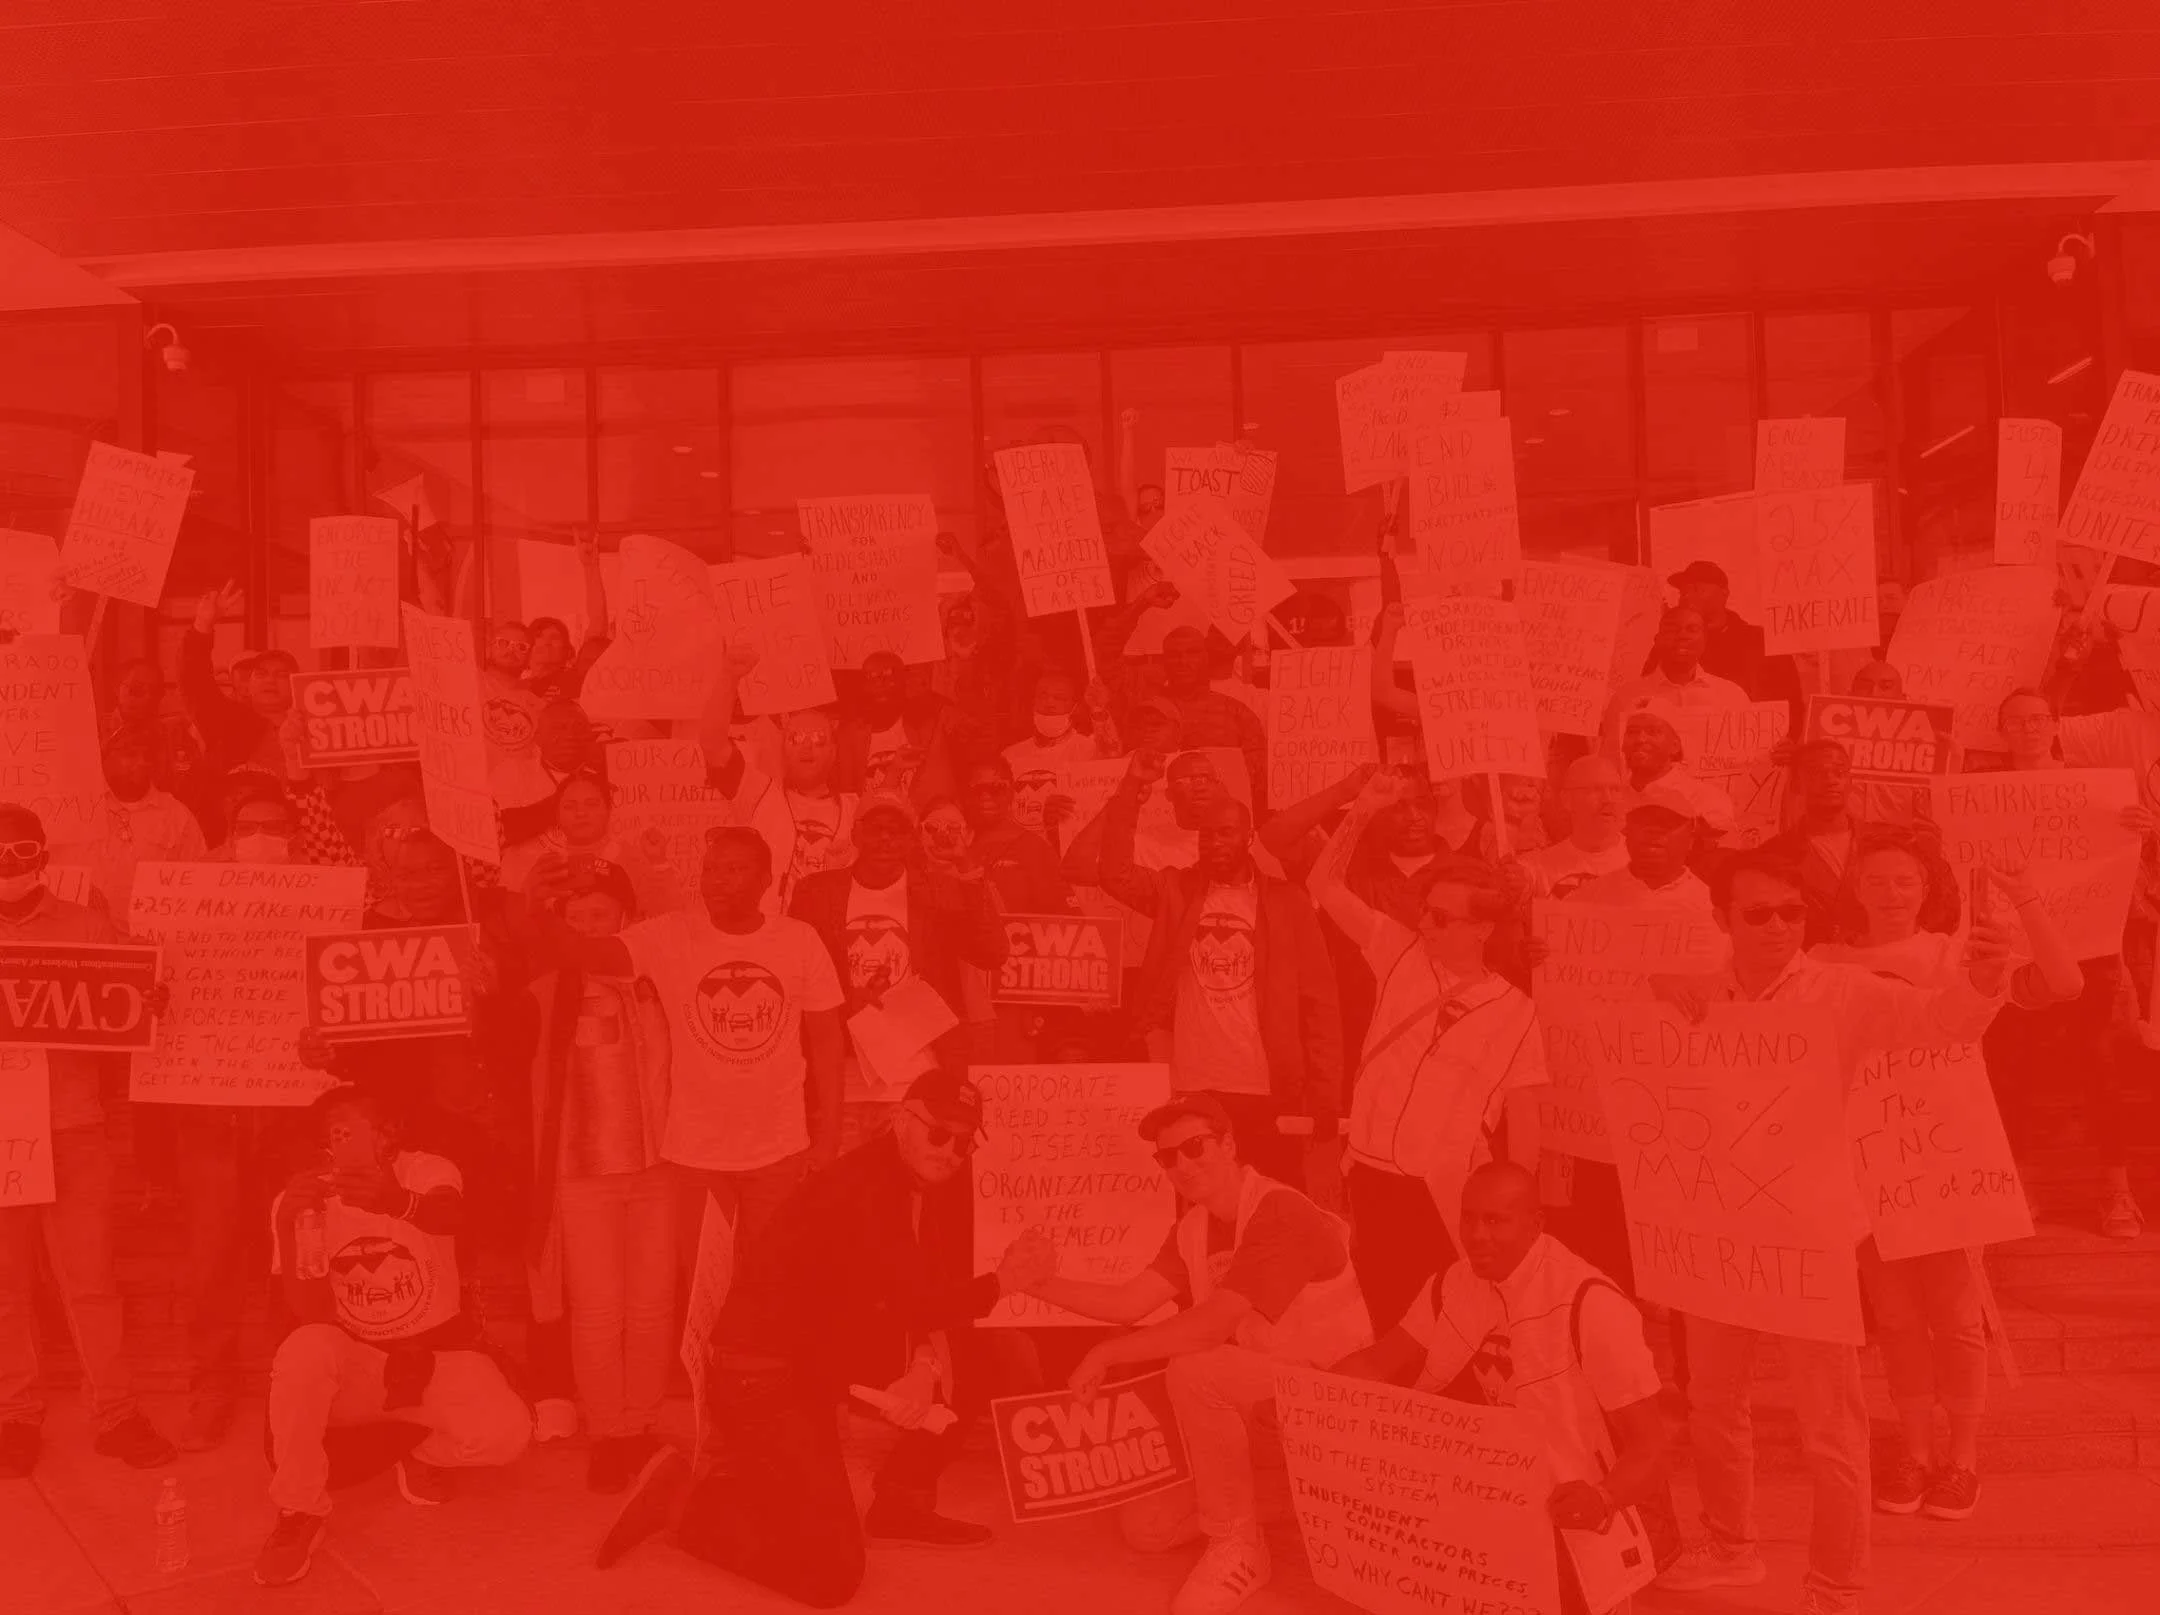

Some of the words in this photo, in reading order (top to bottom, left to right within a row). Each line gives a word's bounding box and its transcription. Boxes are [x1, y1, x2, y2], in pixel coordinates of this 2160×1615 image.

[1415, 425, 1473, 467] END
[2101, 423, 2160, 456] DRIV
[1170, 465, 1242, 500] TOAST
[1010, 481, 1091, 524] TAKE
[316, 520, 393, 546] ENFORCE
[1768, 497, 1864, 552] 25%
[328, 549, 371, 570] THE
[1021, 538, 1102, 576] MAJORITY
[1178, 521, 1228, 569] BACK
[850, 571, 881, 585] AND
[1056, 570, 1082, 588] OF
[1226, 543, 1258, 625] GREED
[1522, 567, 1609, 602] ENFORCE
[1770, 552, 1855, 593] MAX
[715, 568, 795, 625] THE
[1407, 602, 1495, 625] COLORADO
[833, 604, 913, 627] DRIVERS
[1764, 599, 1826, 636] TAKE
[1277, 650, 1357, 690] FIGHT
[1459, 653, 1523, 668] UNITED
[1957, 641, 2024, 666] FAIR
[0, 680, 80, 703] NDENT
[1903, 662, 1951, 690] PAY
[1962, 670, 2015, 690] FOR
[303, 677, 415, 717] CWA
[1278, 694, 1353, 735] BACK
[1428, 688, 1529, 718] STRENGTH
[308, 713, 420, 751] STRON
[1818, 703, 1938, 744] CWA
[615, 746, 668, 771] OUR
[672, 745, 704, 769] CA
[1272, 738, 1369, 759] CORPORATE
[1436, 735, 1529, 771] UNITY
[1849, 739, 1937, 773] RONG
[611, 783, 651, 808] OUR
[1945, 782, 2090, 817] FAIRNESS
[2031, 815, 2083, 841] FOR
[1956, 832, 2092, 866] DRIVERS
[159, 867, 196, 888] WE
[195, 898, 240, 918] MAX
[243, 898, 293, 921] TAKE
[299, 903, 359, 921] RATE
[176, 928, 212, 945] END
[184, 945, 265, 961] WITHOUT
[1003, 921, 1108, 957] CWA
[1544, 914, 1612, 955] END
[1630, 918, 1715, 961] THE
[186, 966, 225, 984] GAS
[236, 966, 304, 984] SURCHA
[318, 936, 463, 984] CWA
[1000, 957, 1109, 990] STRONG
[0, 978, 144, 1033] CWA
[191, 984, 224, 1002] PER
[233, 984, 289, 1002] RIDE
[319, 977, 465, 1024] STRONG
[199, 1032, 242, 1057] TNC
[1591, 1016, 1654, 1066] WE
[1658, 1018, 1811, 1070] DEMAND
[215, 1056, 254, 1071] THE
[1848, 1041, 1974, 1093] NFORCE
[208, 1076, 238, 1091] THE
[977, 1073, 1121, 1104] CORPORATE
[993, 1106, 1049, 1130] REED
[1063, 1107, 1088, 1127] IS
[1104, 1104, 1143, 1125] THE
[1537, 1100, 1606, 1140] ENOUG
[1608, 1074, 1792, 1153] 25%
[1009, 1131, 1125, 1162] DISEASE
[1855, 1121, 1966, 1172] TNC
[978, 1170, 1162, 1200] ORGANIZATION
[1632, 1150, 1796, 1216] MAX
[1876, 1174, 1927, 1217] ACT
[999, 1205, 1025, 1224] IS
[1045, 1202, 1086, 1221] THE
[1089, 1255, 1134, 1274] THE
[1632, 1218, 1706, 1283] TAKE
[1716, 1233, 1832, 1304] RATE
[1274, 1374, 1301, 1398] NO
[1312, 1380, 1483, 1434] DEACTIVATIONS
[1011, 1391, 1161, 1455] CWA
[1368, 1415, 1538, 1472] REPRESENTATION
[1019, 1431, 1172, 1499] STRONG
[1286, 1440, 1322, 1465] END
[1328, 1445, 1374, 1474] THE
[1379, 1455, 1441, 1487] RACIST
[1452, 1474, 1530, 1507] RATING
[1295, 1474, 1431, 1530] INDEPENDENT
[1362, 1477, 1441, 1509] SYSTEM
[1345, 1510, 1489, 1568] CONTRACTORS
[1345, 1527, 1403, 1562] THEIR
[1410, 1551, 1448, 1577] OWN
[1304, 1536, 1338, 1570] SO
[1346, 1550, 1393, 1589] WHY
